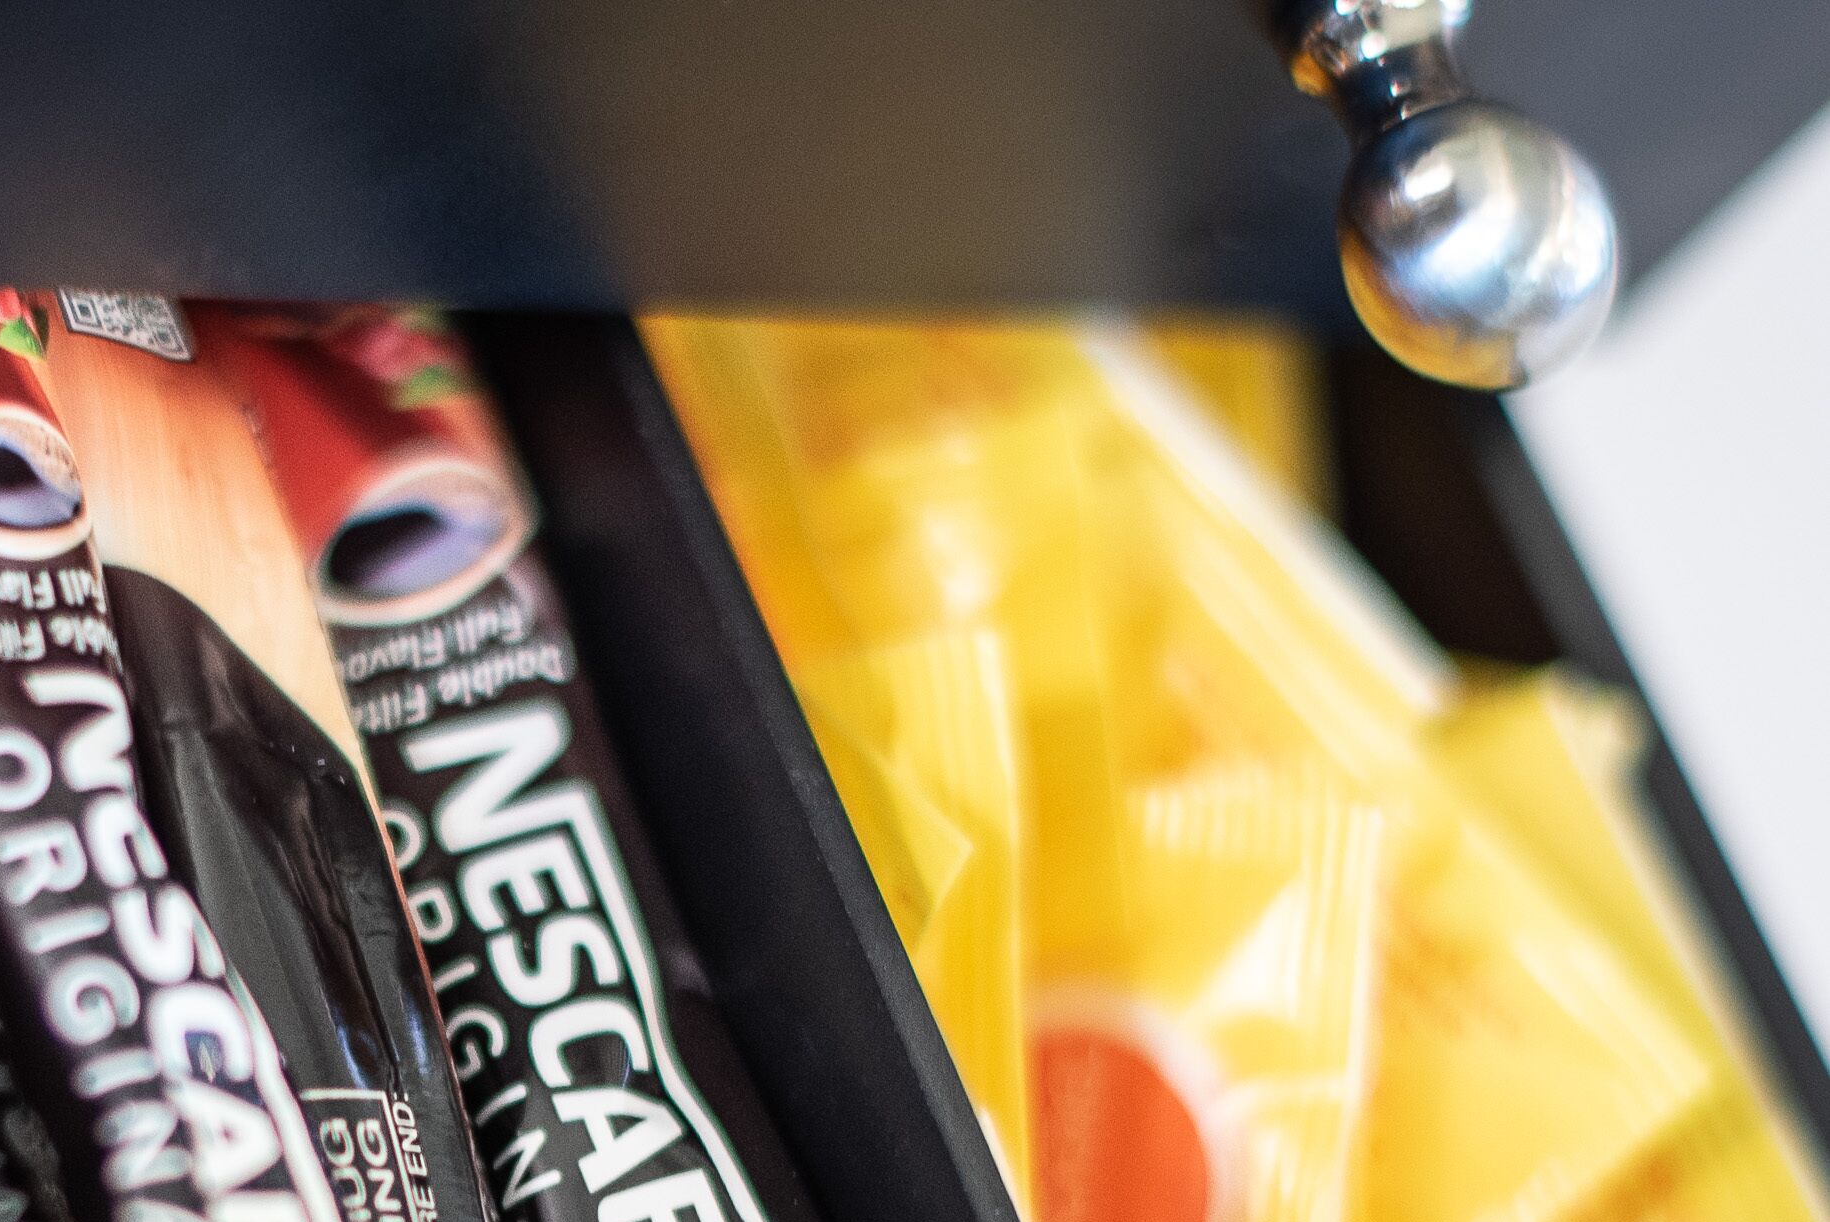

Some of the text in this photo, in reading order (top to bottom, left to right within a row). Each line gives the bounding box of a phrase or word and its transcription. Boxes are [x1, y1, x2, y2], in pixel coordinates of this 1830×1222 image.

[456, 603, 524, 656] Full
[436, 644, 567, 706] Double
[392, 1092, 428, 1178] END:
